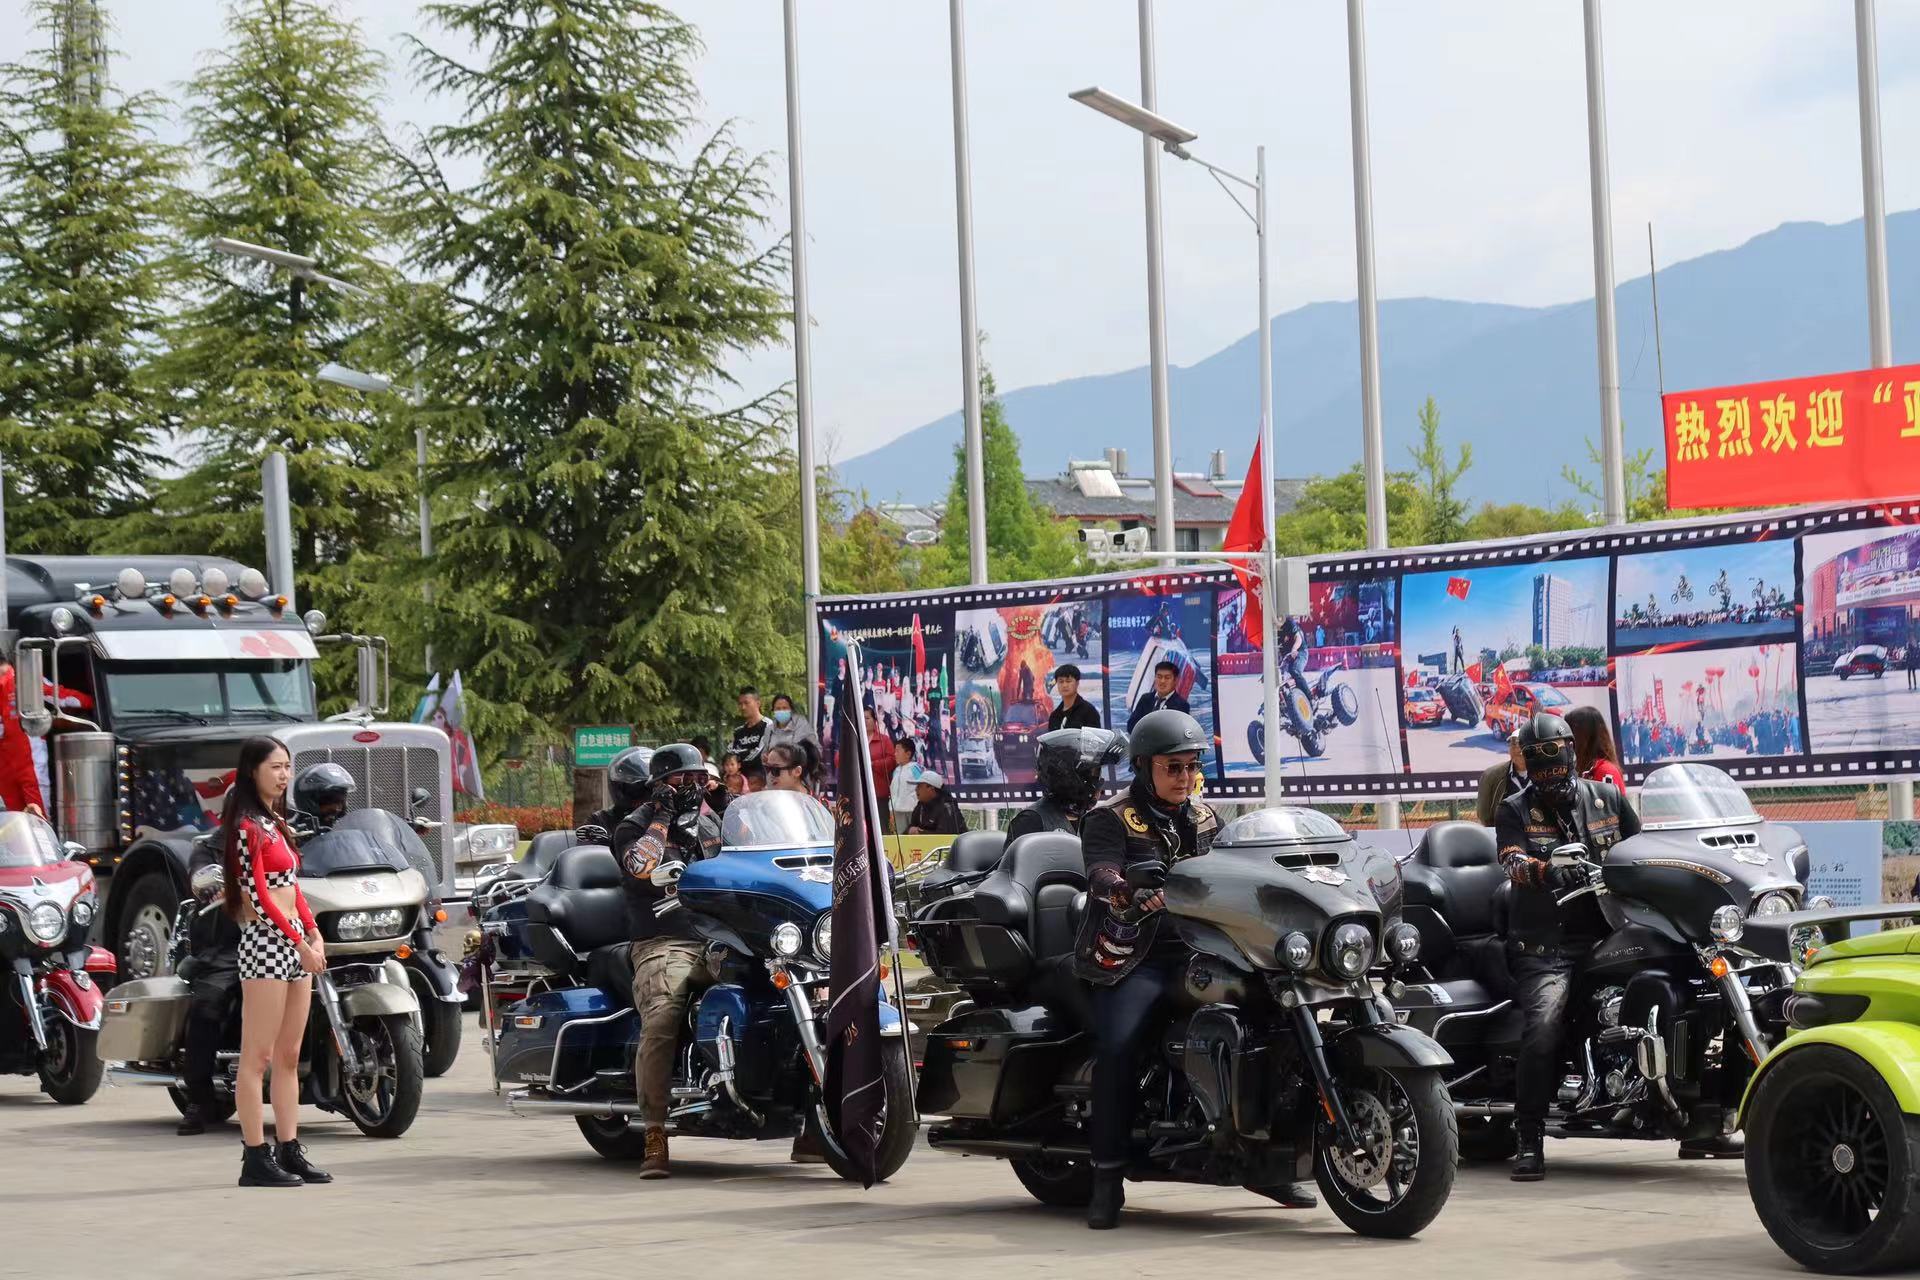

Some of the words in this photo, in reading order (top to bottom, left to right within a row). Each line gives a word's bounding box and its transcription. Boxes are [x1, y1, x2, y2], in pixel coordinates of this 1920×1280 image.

[580, 734, 630, 747] 应急避难场所
